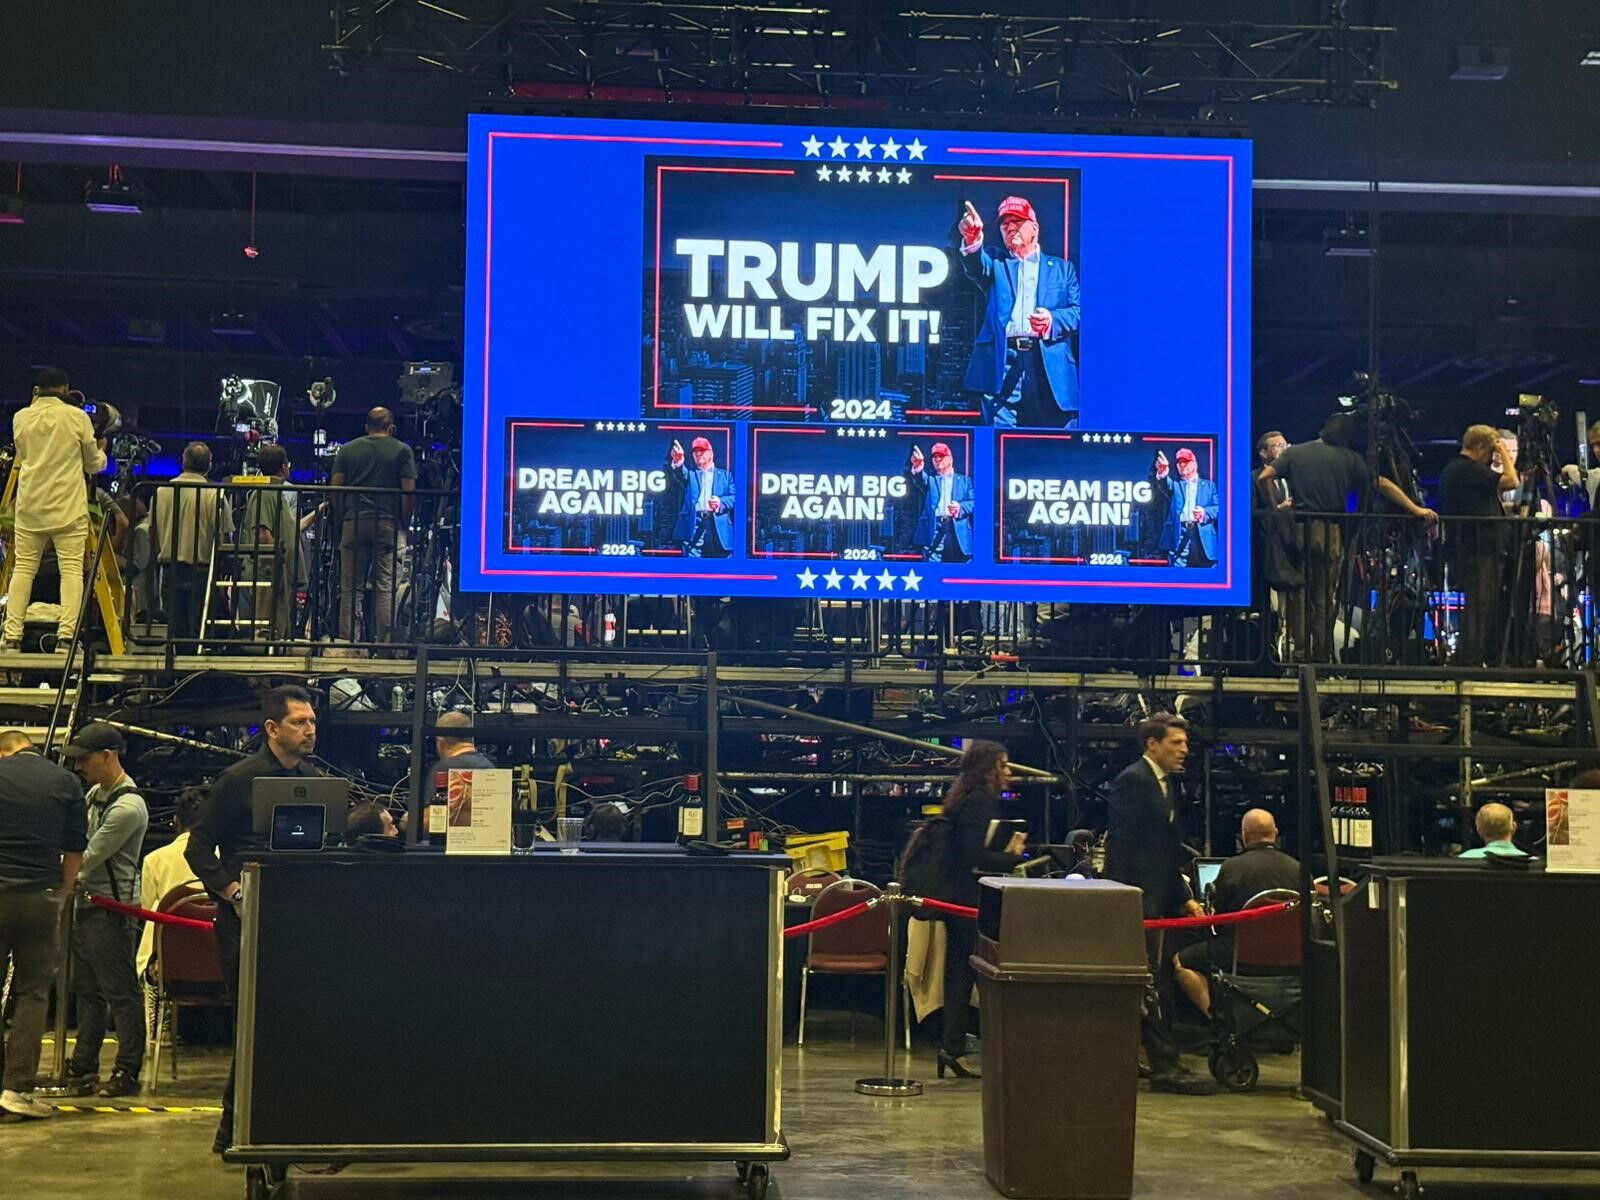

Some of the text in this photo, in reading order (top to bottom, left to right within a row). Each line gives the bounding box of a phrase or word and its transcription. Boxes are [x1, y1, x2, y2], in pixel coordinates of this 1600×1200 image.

[676, 239, 949, 304] TRUMP
[684, 303, 941, 345] WILL FIX IT!
[830, 399, 893, 420] 2024
[518, 467, 667, 493] DREAM BIG
[761, 473, 907, 498] DREAM BIG
[1008, 478, 1153, 504] DREAM BIG
[538, 490, 645, 516] AGAIN!
[780, 495, 885, 521] AGAIN!
[1027, 501, 1131, 526] AGAIN!
[602, 543, 636, 556] 2024
[843, 548, 877, 561] 2024
[1089, 553, 1123, 566] 2024
